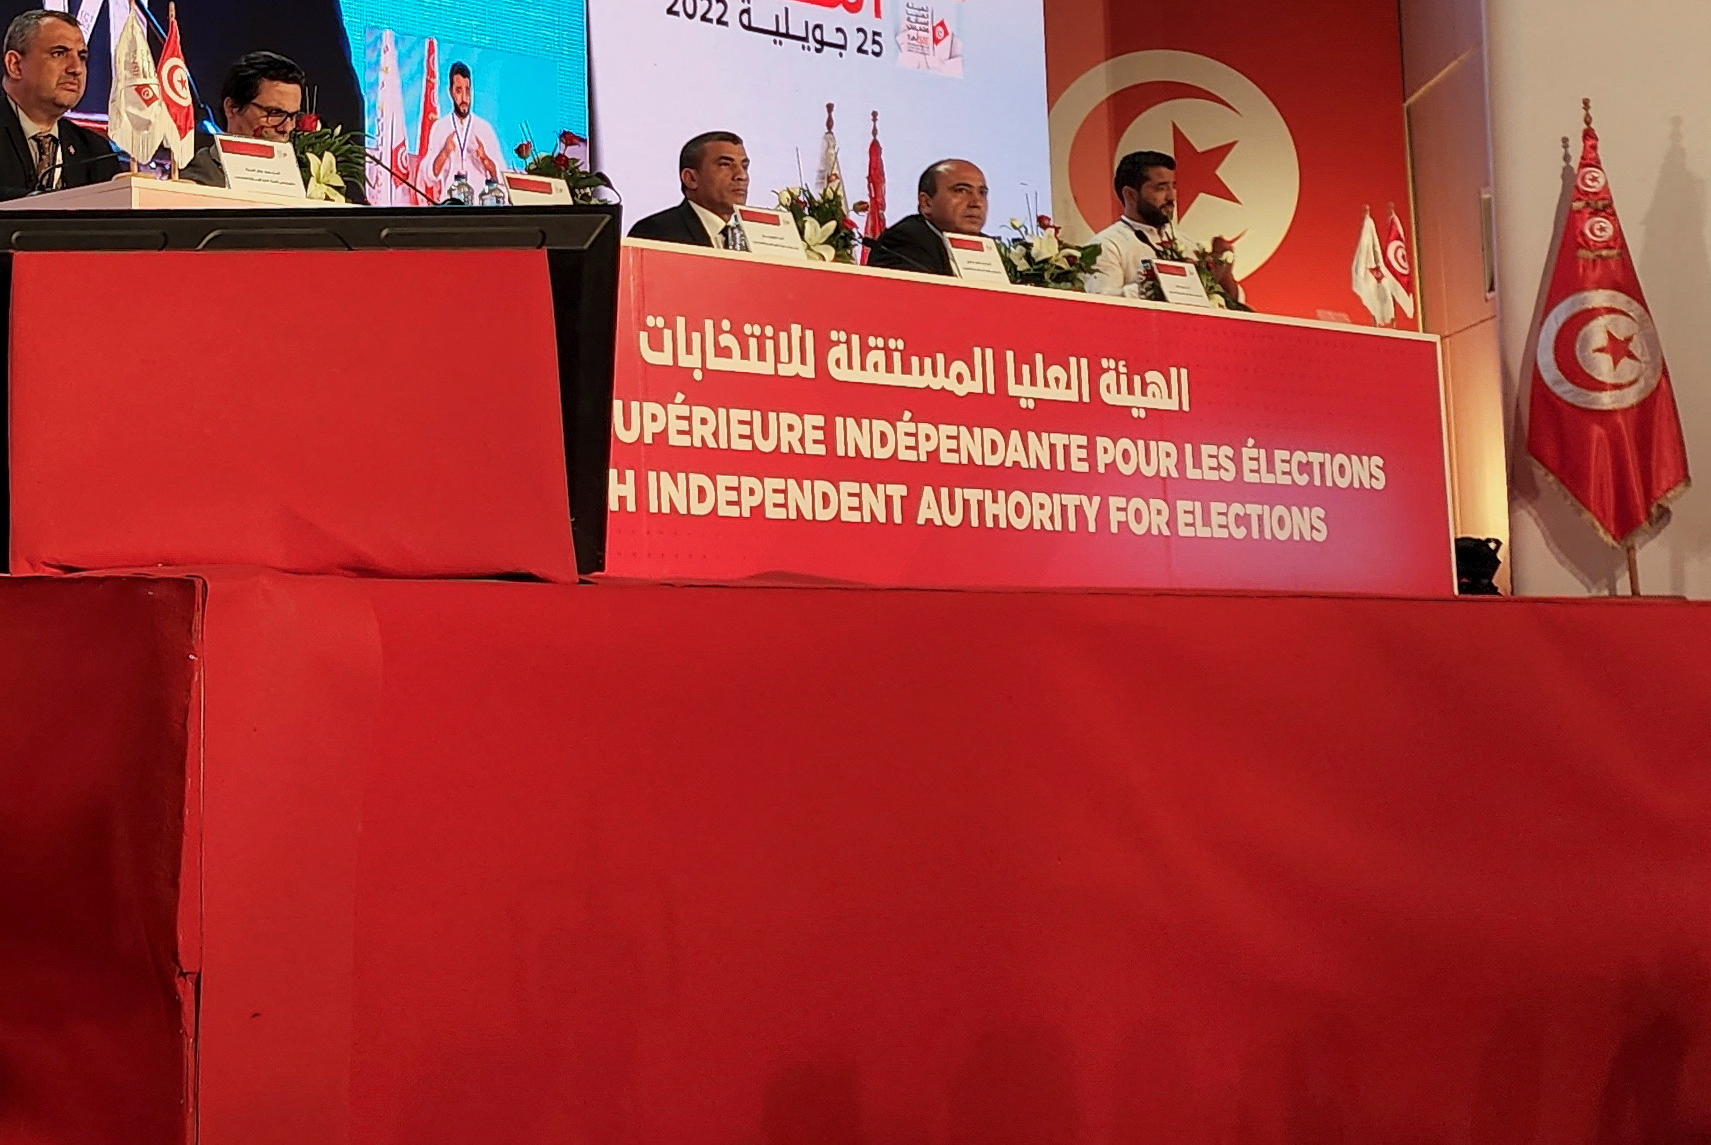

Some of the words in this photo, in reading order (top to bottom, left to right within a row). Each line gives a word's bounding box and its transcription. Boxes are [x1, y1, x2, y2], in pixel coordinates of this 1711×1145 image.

[856, 27, 884, 58] 25
[639, 315, 816, 381] للانتخابات
[827, 329, 995, 396] المستقلة
[1006, 350, 1090, 409] العليا
[1100, 357, 1190, 418] الهيئة
[613, 392, 826, 455] UPÉRIEURE
[835, 410, 1089, 473] INDÉPENDANTE
[1096, 436, 1178, 479] POUR
[1185, 443, 1237, 482] LES
[1242, 438, 1386, 490] ÉLECTIONS
[647, 469, 907, 524] INDEPENDENT
[917, 485, 1101, 534] AUTHORITY
[1108, 495, 1171, 537] FOR
[1177, 500, 1328, 543] ELECTIONS
